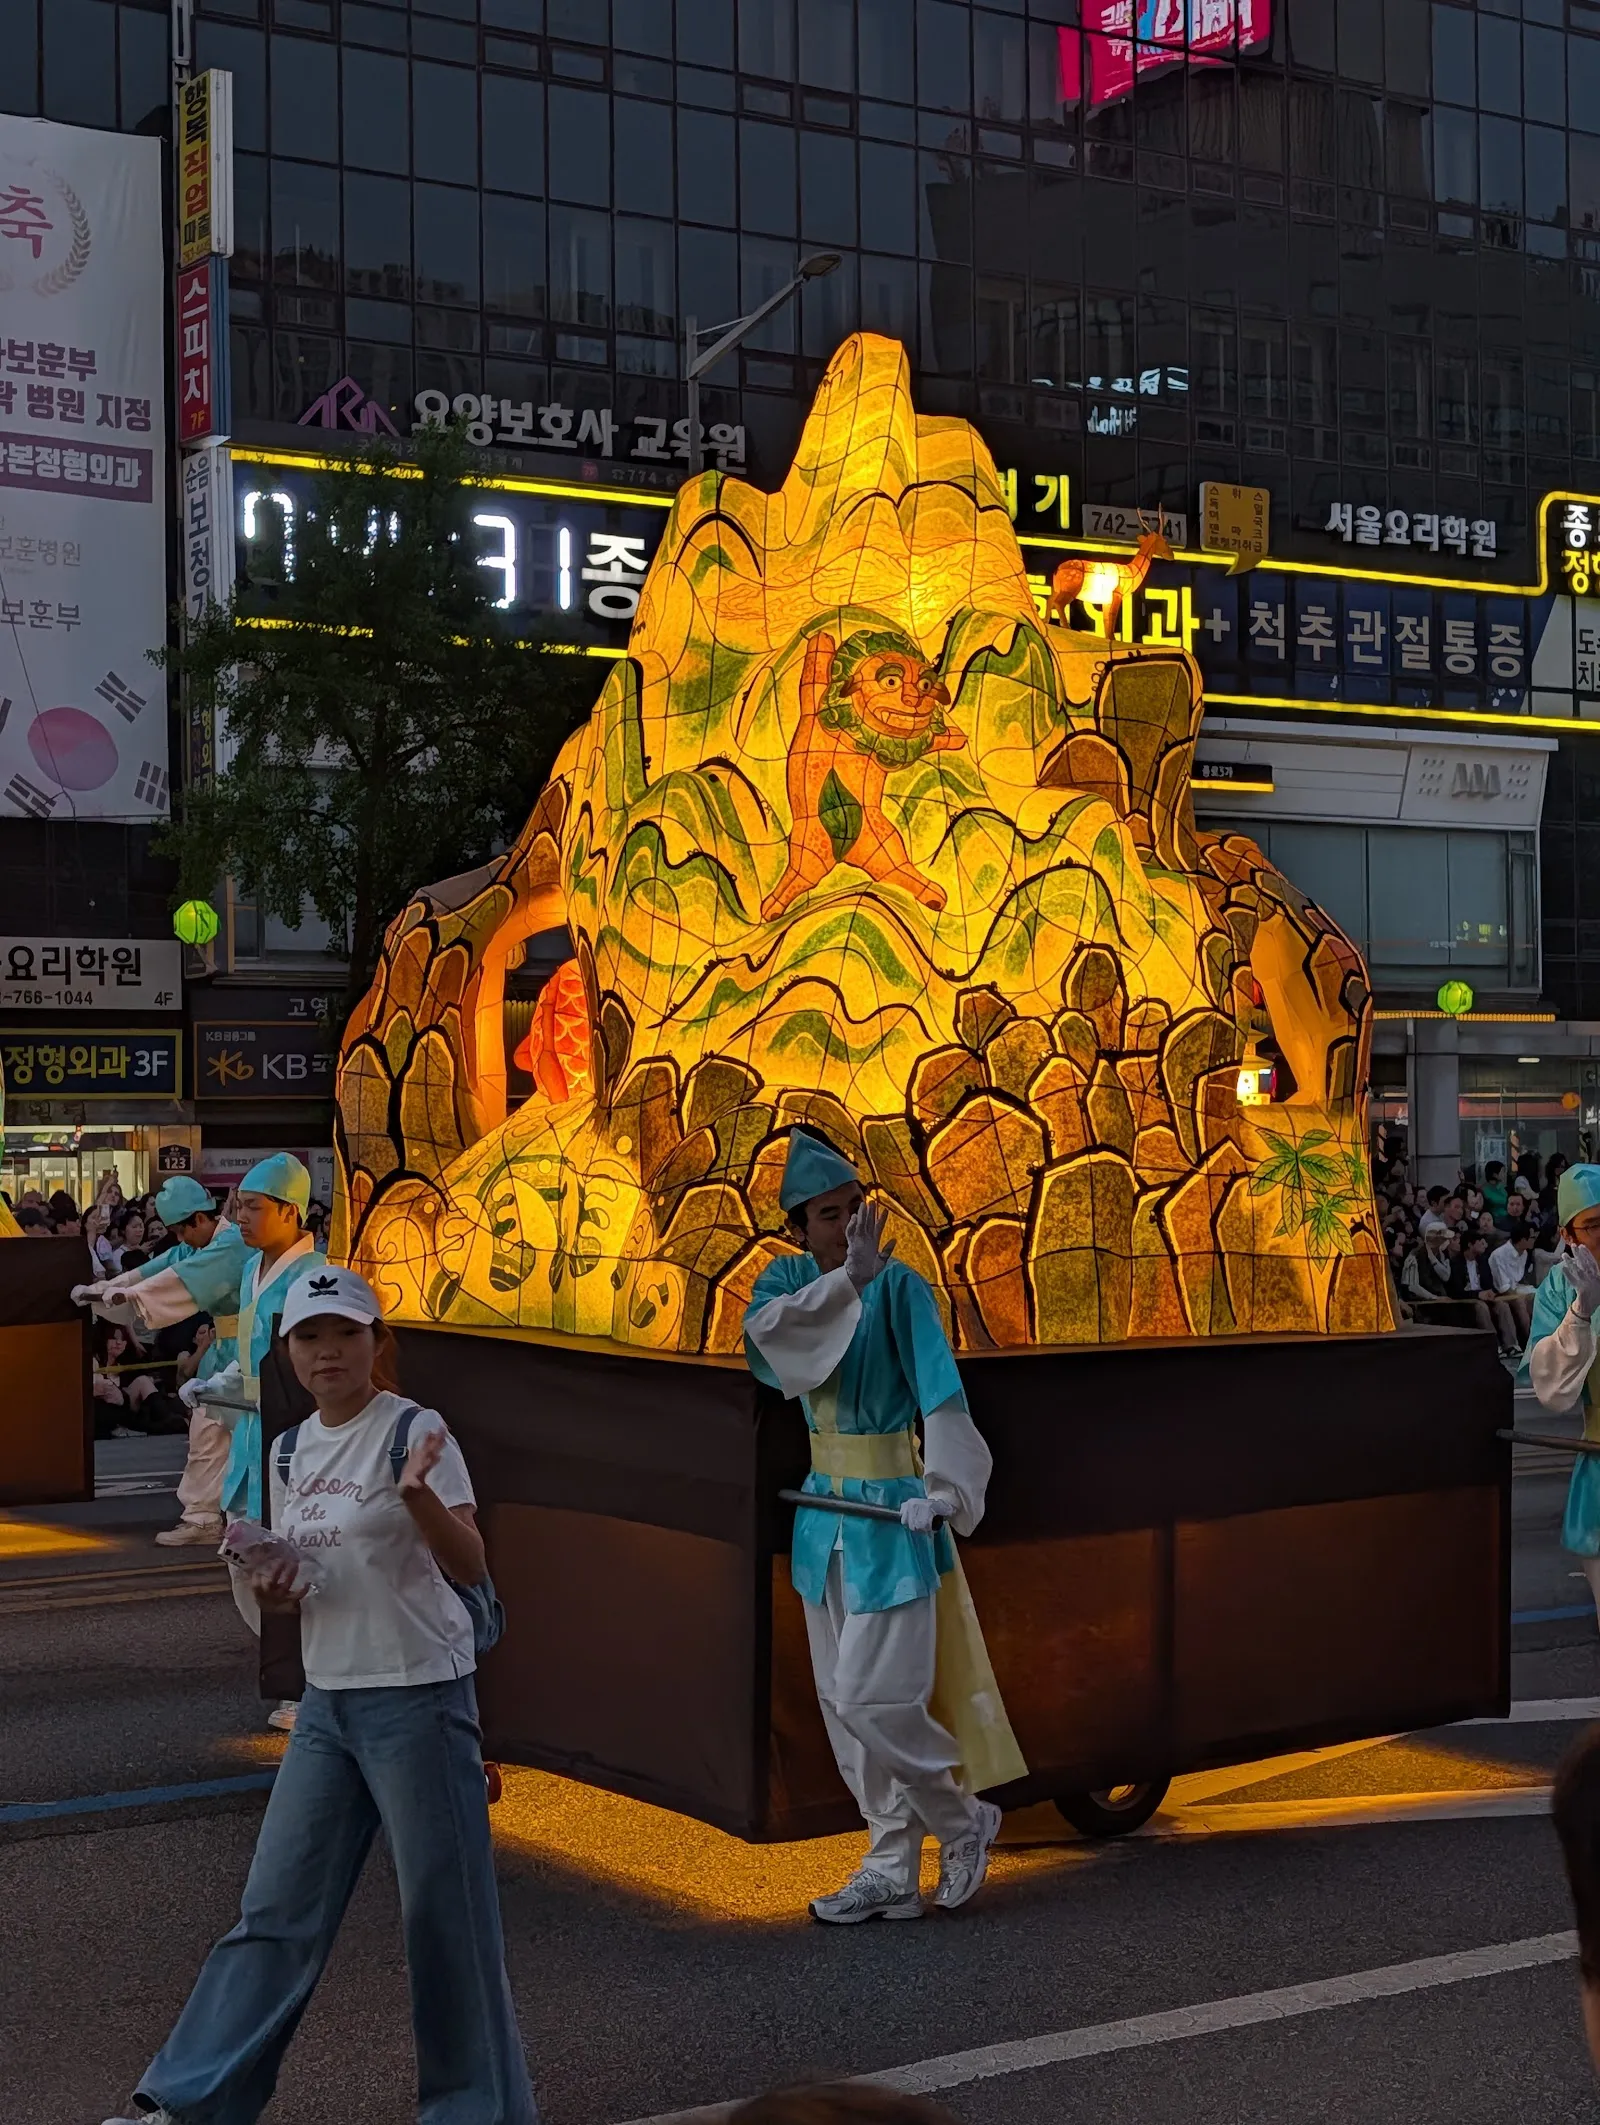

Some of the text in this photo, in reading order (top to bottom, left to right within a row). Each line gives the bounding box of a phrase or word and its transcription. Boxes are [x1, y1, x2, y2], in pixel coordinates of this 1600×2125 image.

[182, 278, 208, 405] 스피치
[26, 383, 85, 424] 병원
[95, 393, 152, 432] 지정
[190, 411, 205, 433] 7F
[410, 388, 618, 458] 요양보호사
[1323, 505, 1490, 558] 서울요리학원
[1560, 504, 1600, 549] 종
[1560, 549, 1600, 596] 정
[1248, 602, 1525, 678] 척추관절통증
[0, 945, 142, 987] 요리학원
[153, 991, 174, 1006] 4F
[4, 1045, 170, 1086] 정형외과 3F
[164, 1157, 187, 1169] 123
[300, 1503, 326, 1522] the
[286, 1525, 342, 1550] heart
